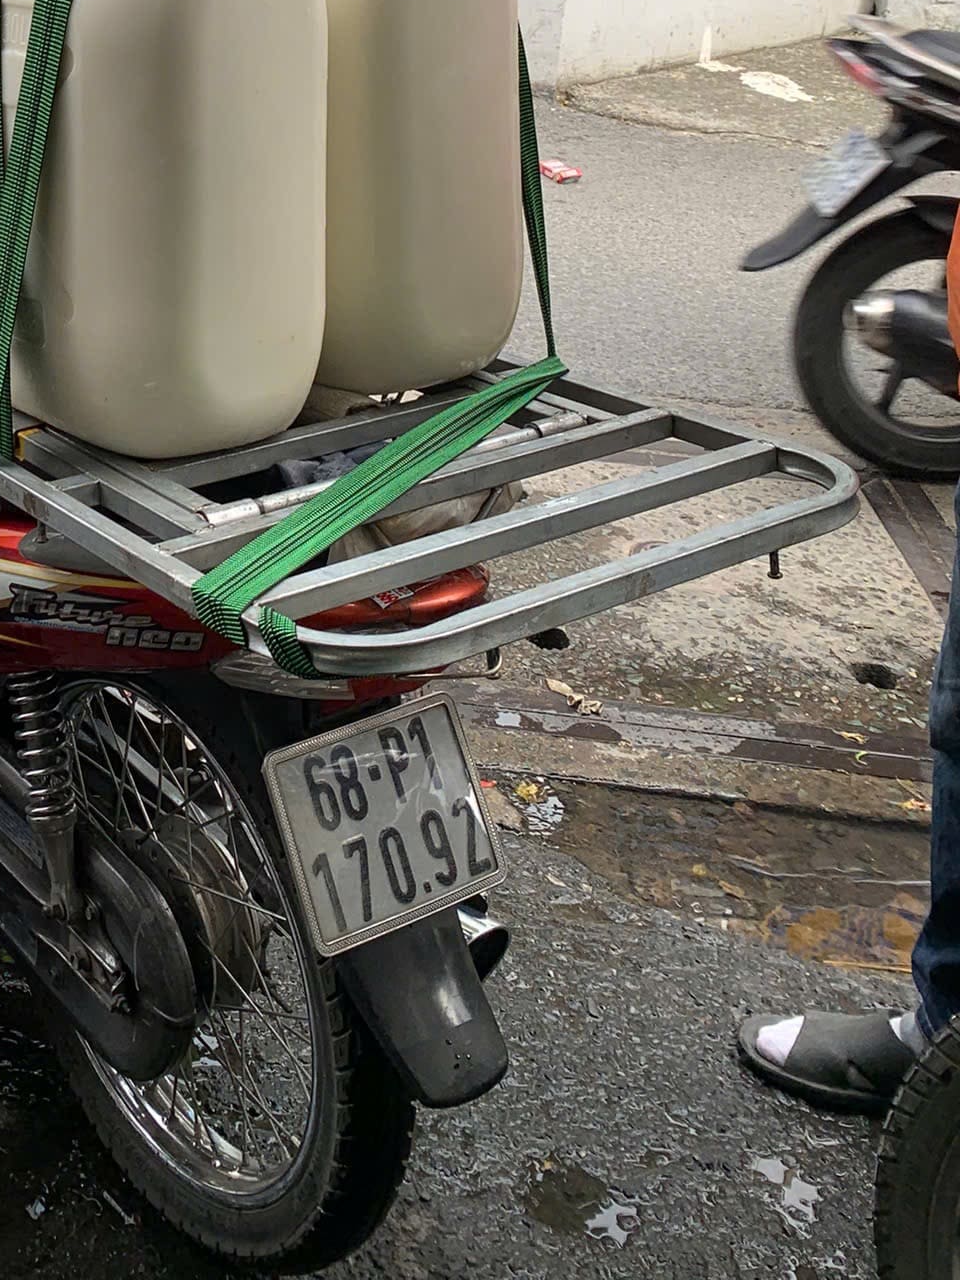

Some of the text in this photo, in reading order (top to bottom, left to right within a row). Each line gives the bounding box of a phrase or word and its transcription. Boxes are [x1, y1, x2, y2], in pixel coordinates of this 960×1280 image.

[9, 582, 161, 628] Future
[302, 716, 444, 832] 68-P1
[310, 797, 493, 932] 170.92
